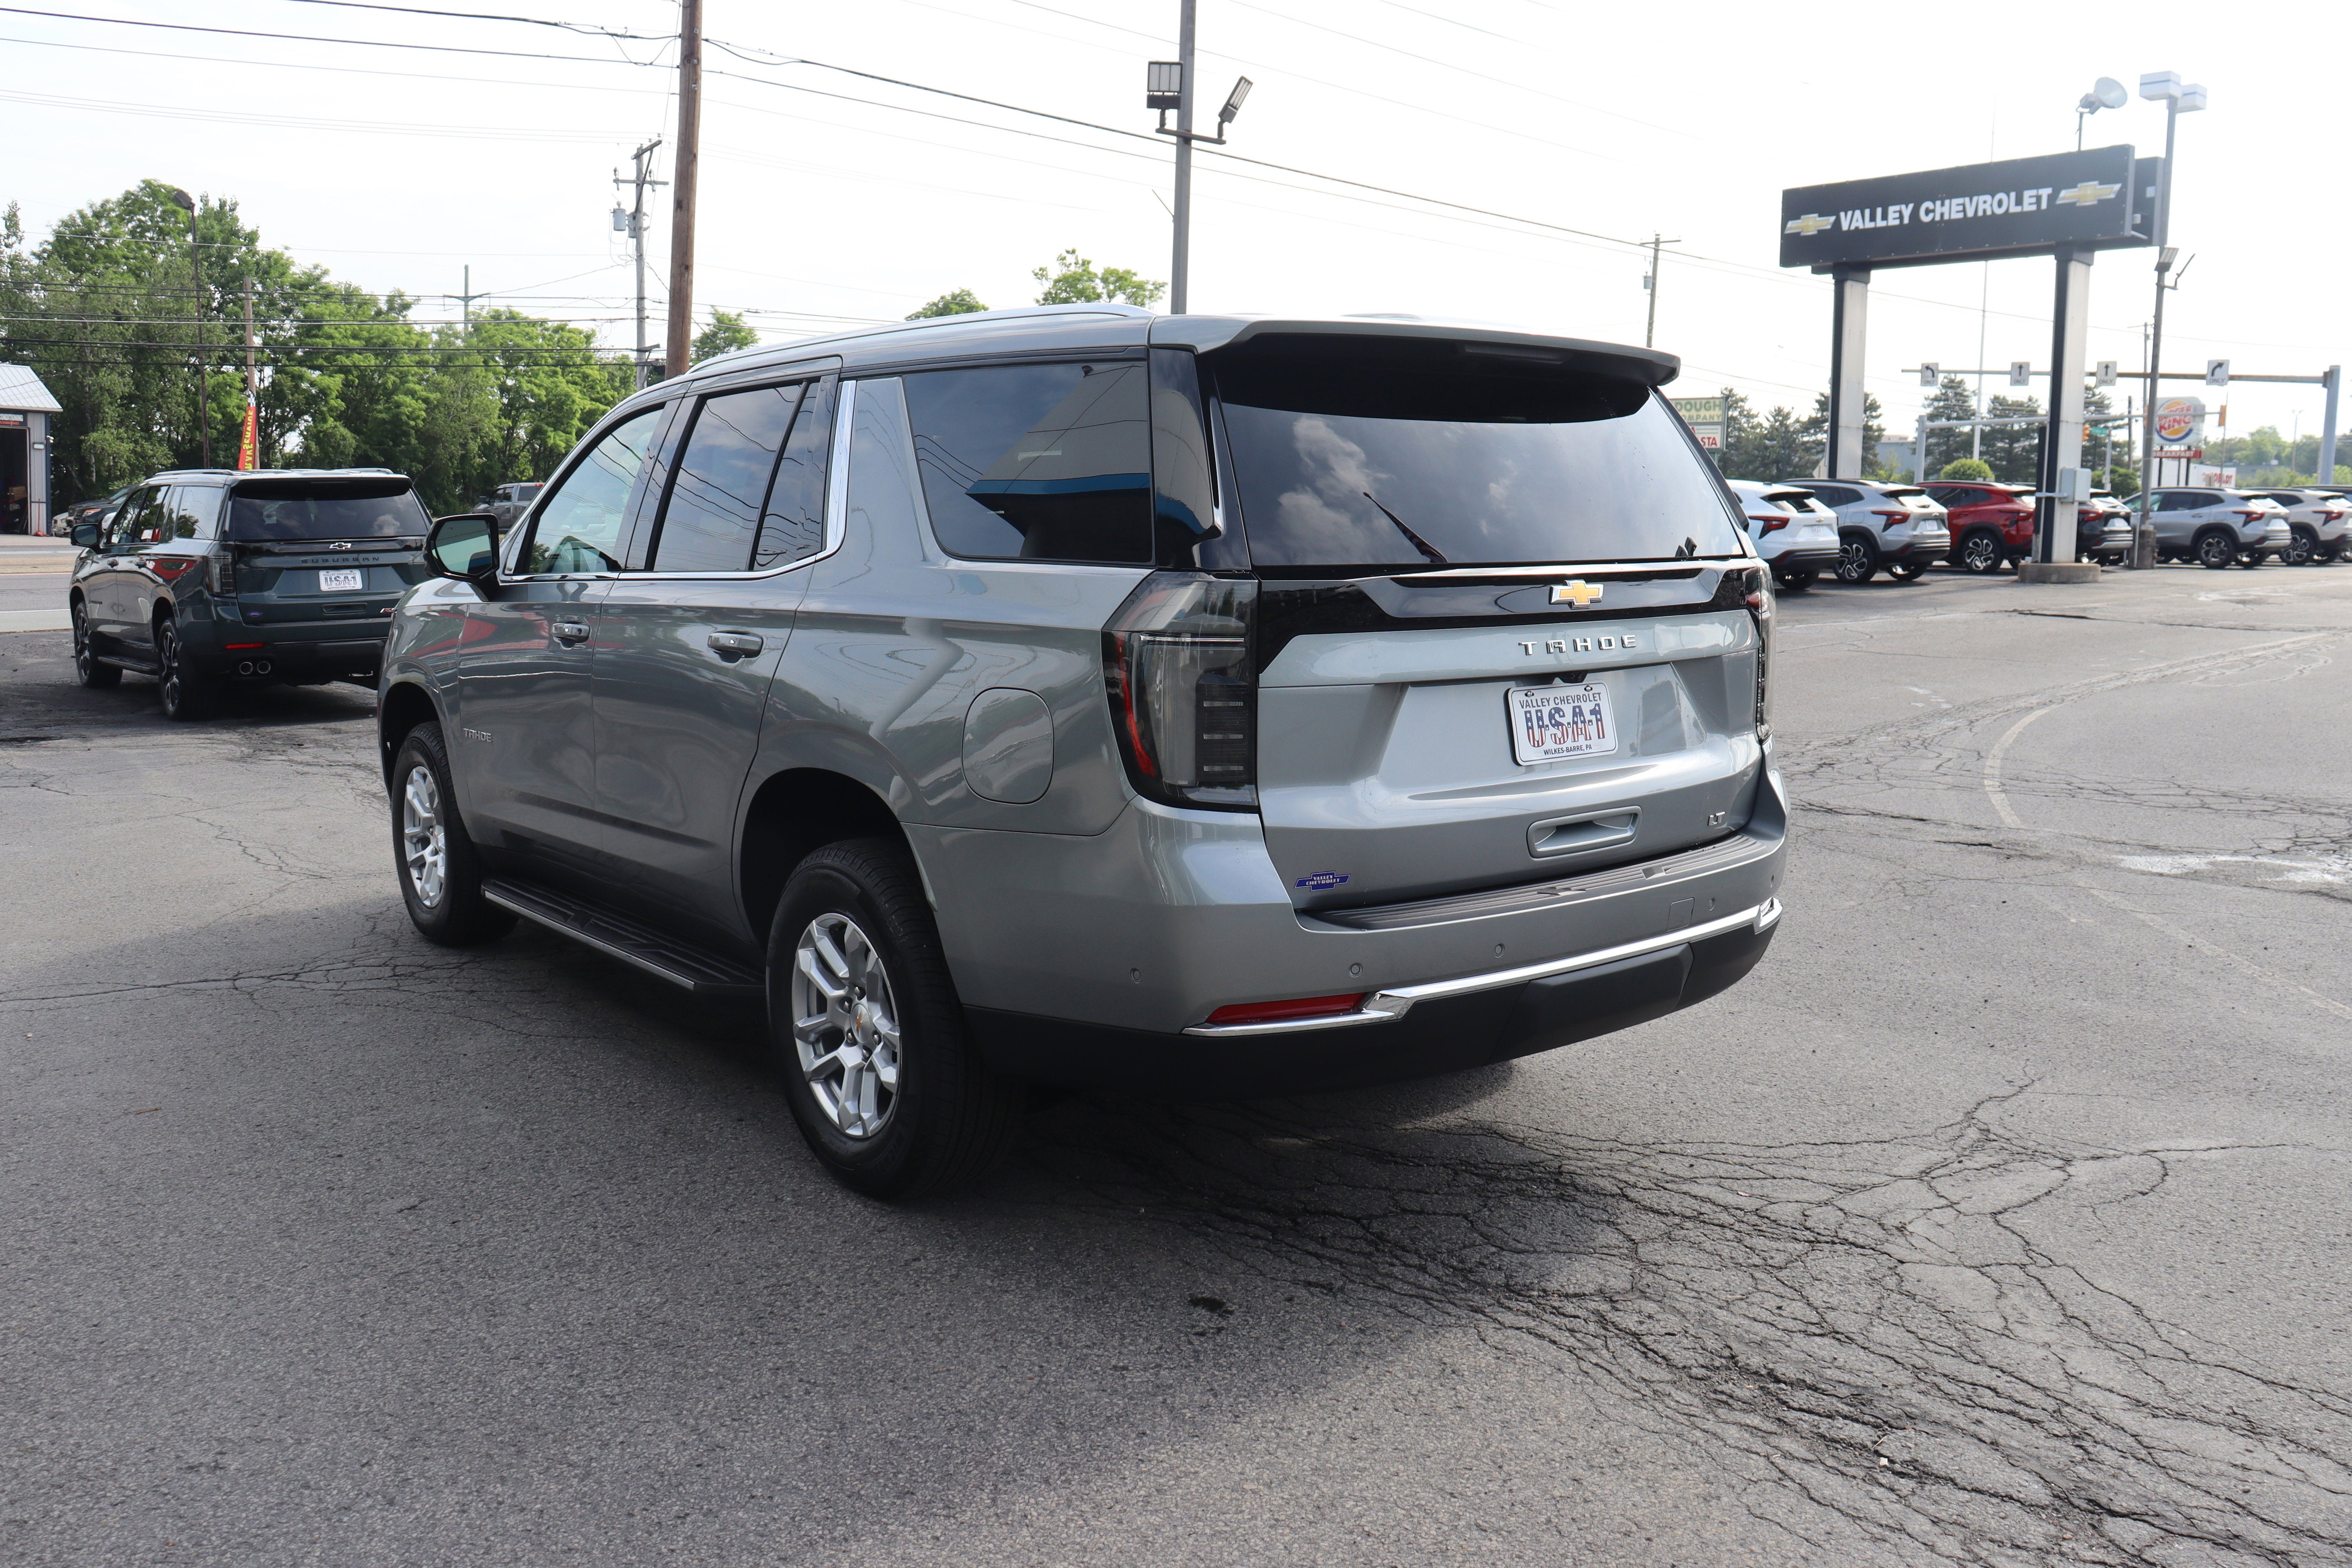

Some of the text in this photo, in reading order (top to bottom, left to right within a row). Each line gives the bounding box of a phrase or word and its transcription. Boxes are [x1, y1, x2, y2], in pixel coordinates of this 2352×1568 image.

[1840, 187, 2053, 231] VALLEY CHEVROLET
[1675, 401, 1722, 412] DOUGH
[1518, 634, 1637, 655] TAHOE
[1519, 692, 1602, 709] VALLEY CHEVROLET
[463, 728, 493, 742] TAHOE
[1543, 745, 1585, 756] WILKES-BARRE,
[1708, 811, 1726, 826] LT
